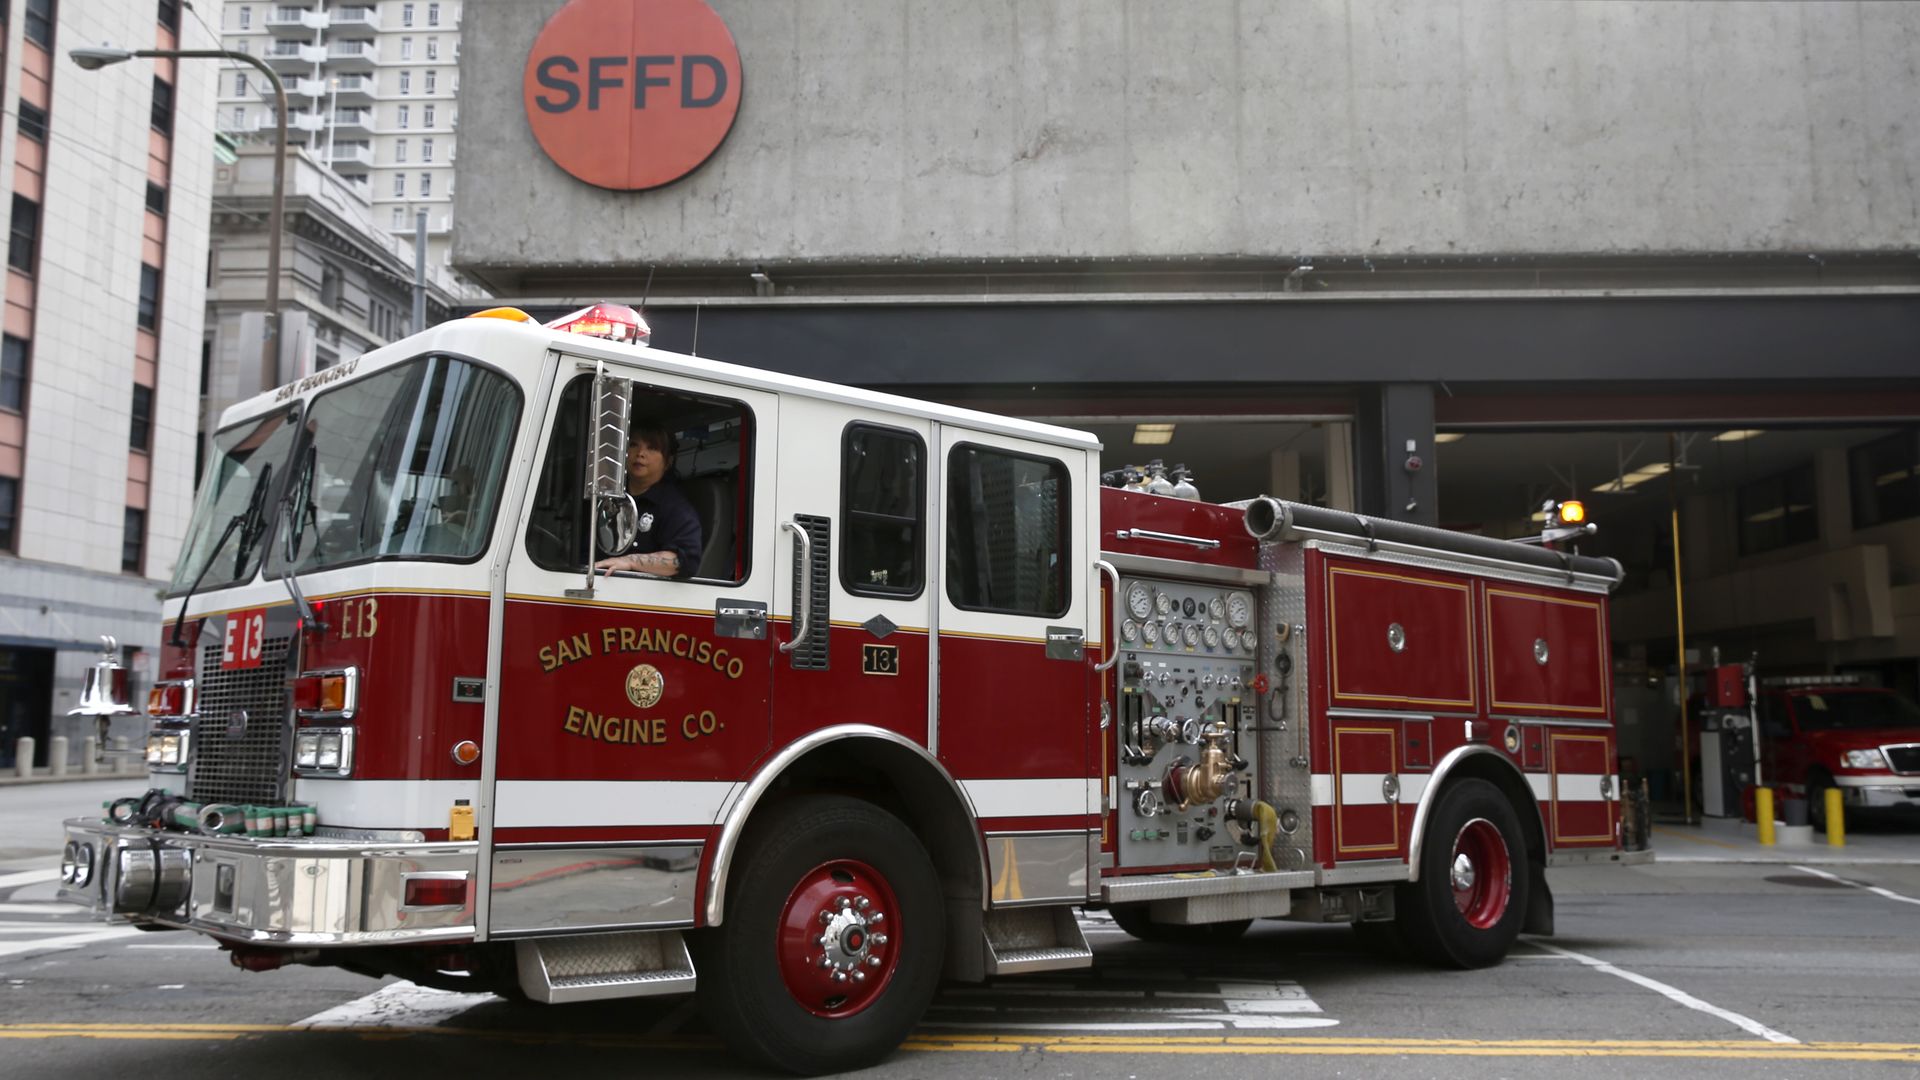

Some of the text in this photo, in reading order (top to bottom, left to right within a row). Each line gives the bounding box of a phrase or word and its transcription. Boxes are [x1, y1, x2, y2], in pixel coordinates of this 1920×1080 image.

[535, 54, 728, 114] SFFD
[538, 627, 744, 679] SAN FRANCISCO
[872, 648, 890, 671] 13
[564, 705, 725, 744] ENGINE CO.
